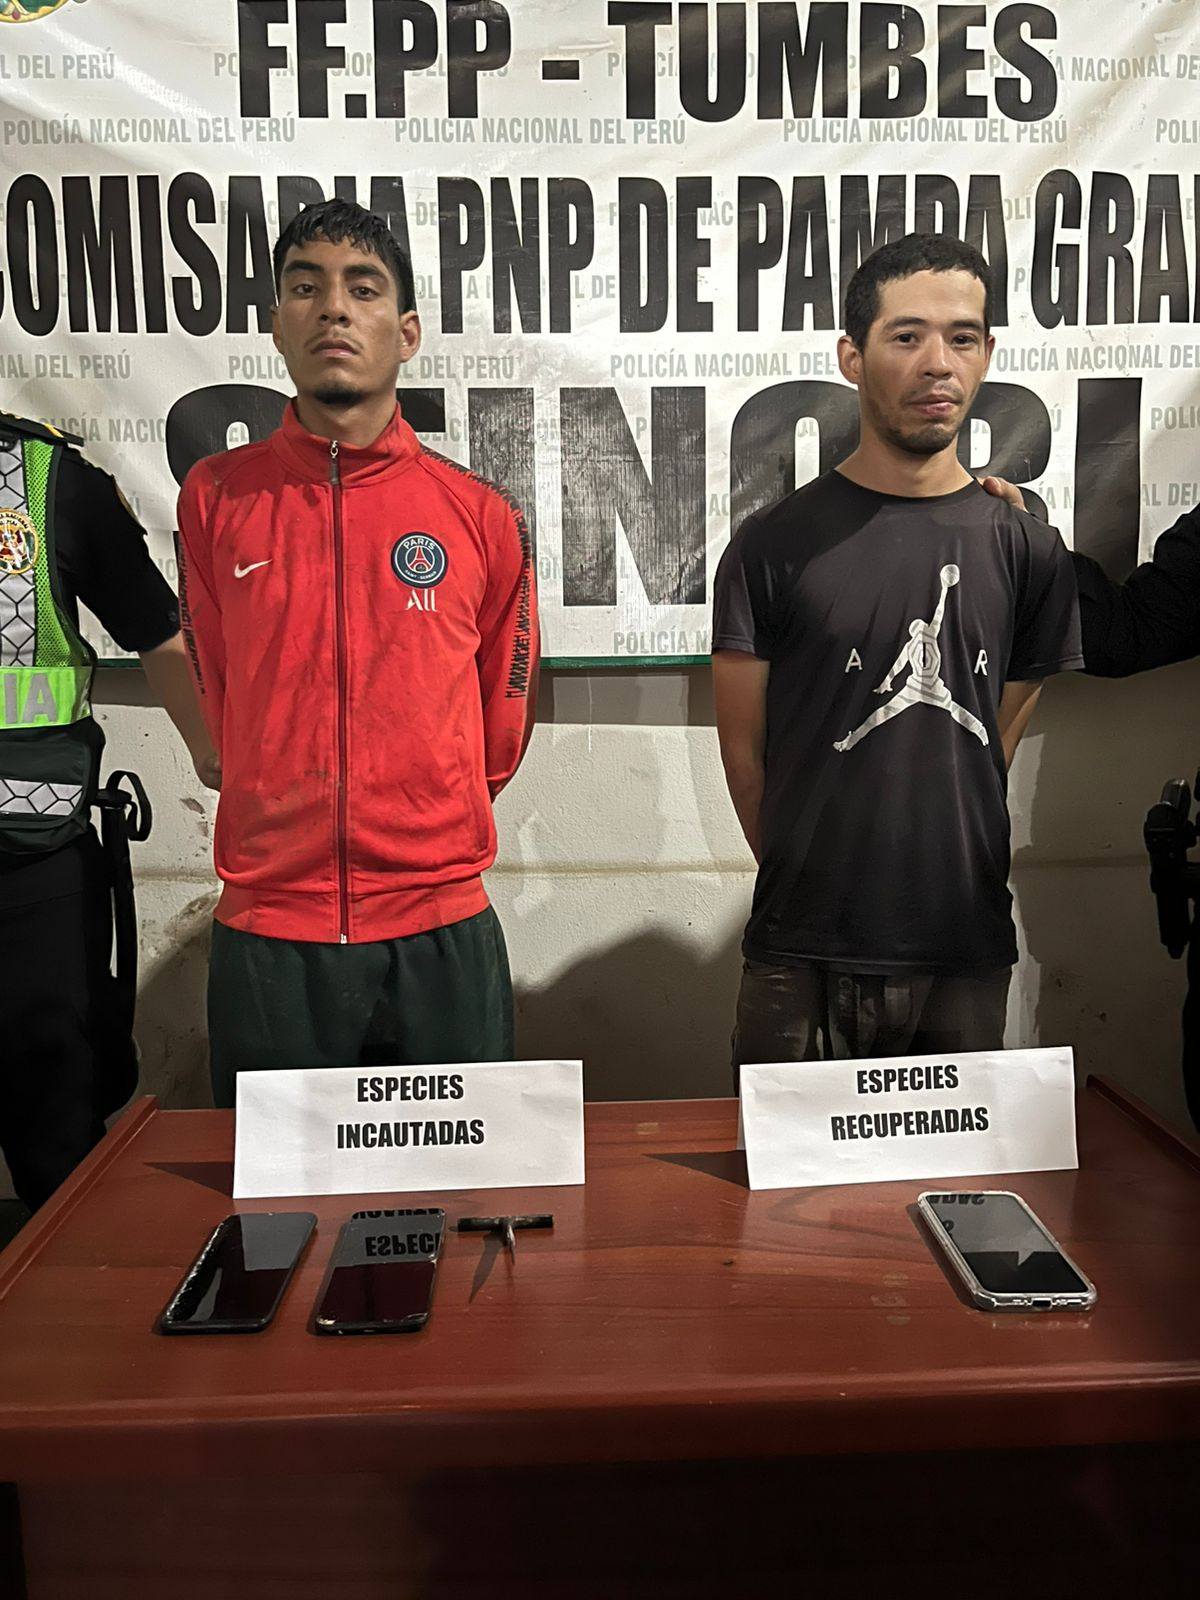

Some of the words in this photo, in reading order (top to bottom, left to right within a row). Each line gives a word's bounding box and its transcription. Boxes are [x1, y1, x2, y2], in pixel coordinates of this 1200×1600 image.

[17, 55, 55, 80] DEL
[63, 47, 115, 80] PERÚ
[238, 0, 511, 118] FF.PP
[607, 2, 1057, 122] TUMBES
[1071, 54, 1170, 82] NACIONAL
[4, 114, 83, 145] POLICÍA
[89, 118, 192, 144] NACIONAL
[199, 118, 235, 143] DEL
[242, 113, 296, 143] PERÚ
[481, 117, 583, 144] NACIONAL
[590, 118, 626, 144] DEL
[633, 113, 686, 144] PERÚ
[869, 118, 968, 143] NACIONAL
[975, 118, 1010, 143] DEL
[1016, 114, 1067, 144] PERÚ
[437, 176, 595, 334] PNP
[618, 176, 714, 334] DE
[1031, 168, 1200, 329] GRA
[35, 354, 73, 379] DEL
[79, 348, 131, 379] PERÚ
[420, 355, 456, 379] DEL
[463, 349, 514, 379] PERÚ
[610, 348, 688, 378] POLICÍA
[695, 352, 792, 377] NACIONAL
[799, 351, 834, 376] DEL
[1066, 344, 1163, 372] NACIONAL
[403, 537, 436, 551] PARIS
[613, 625, 689, 655] POLICÍA
[357, 1074, 464, 1102] ESPECIES
[856, 1064, 959, 1095] ESPECIES
[337, 1119, 485, 1150] INCAUTADAS
[830, 1106, 989, 1141] RECUPERADAS
